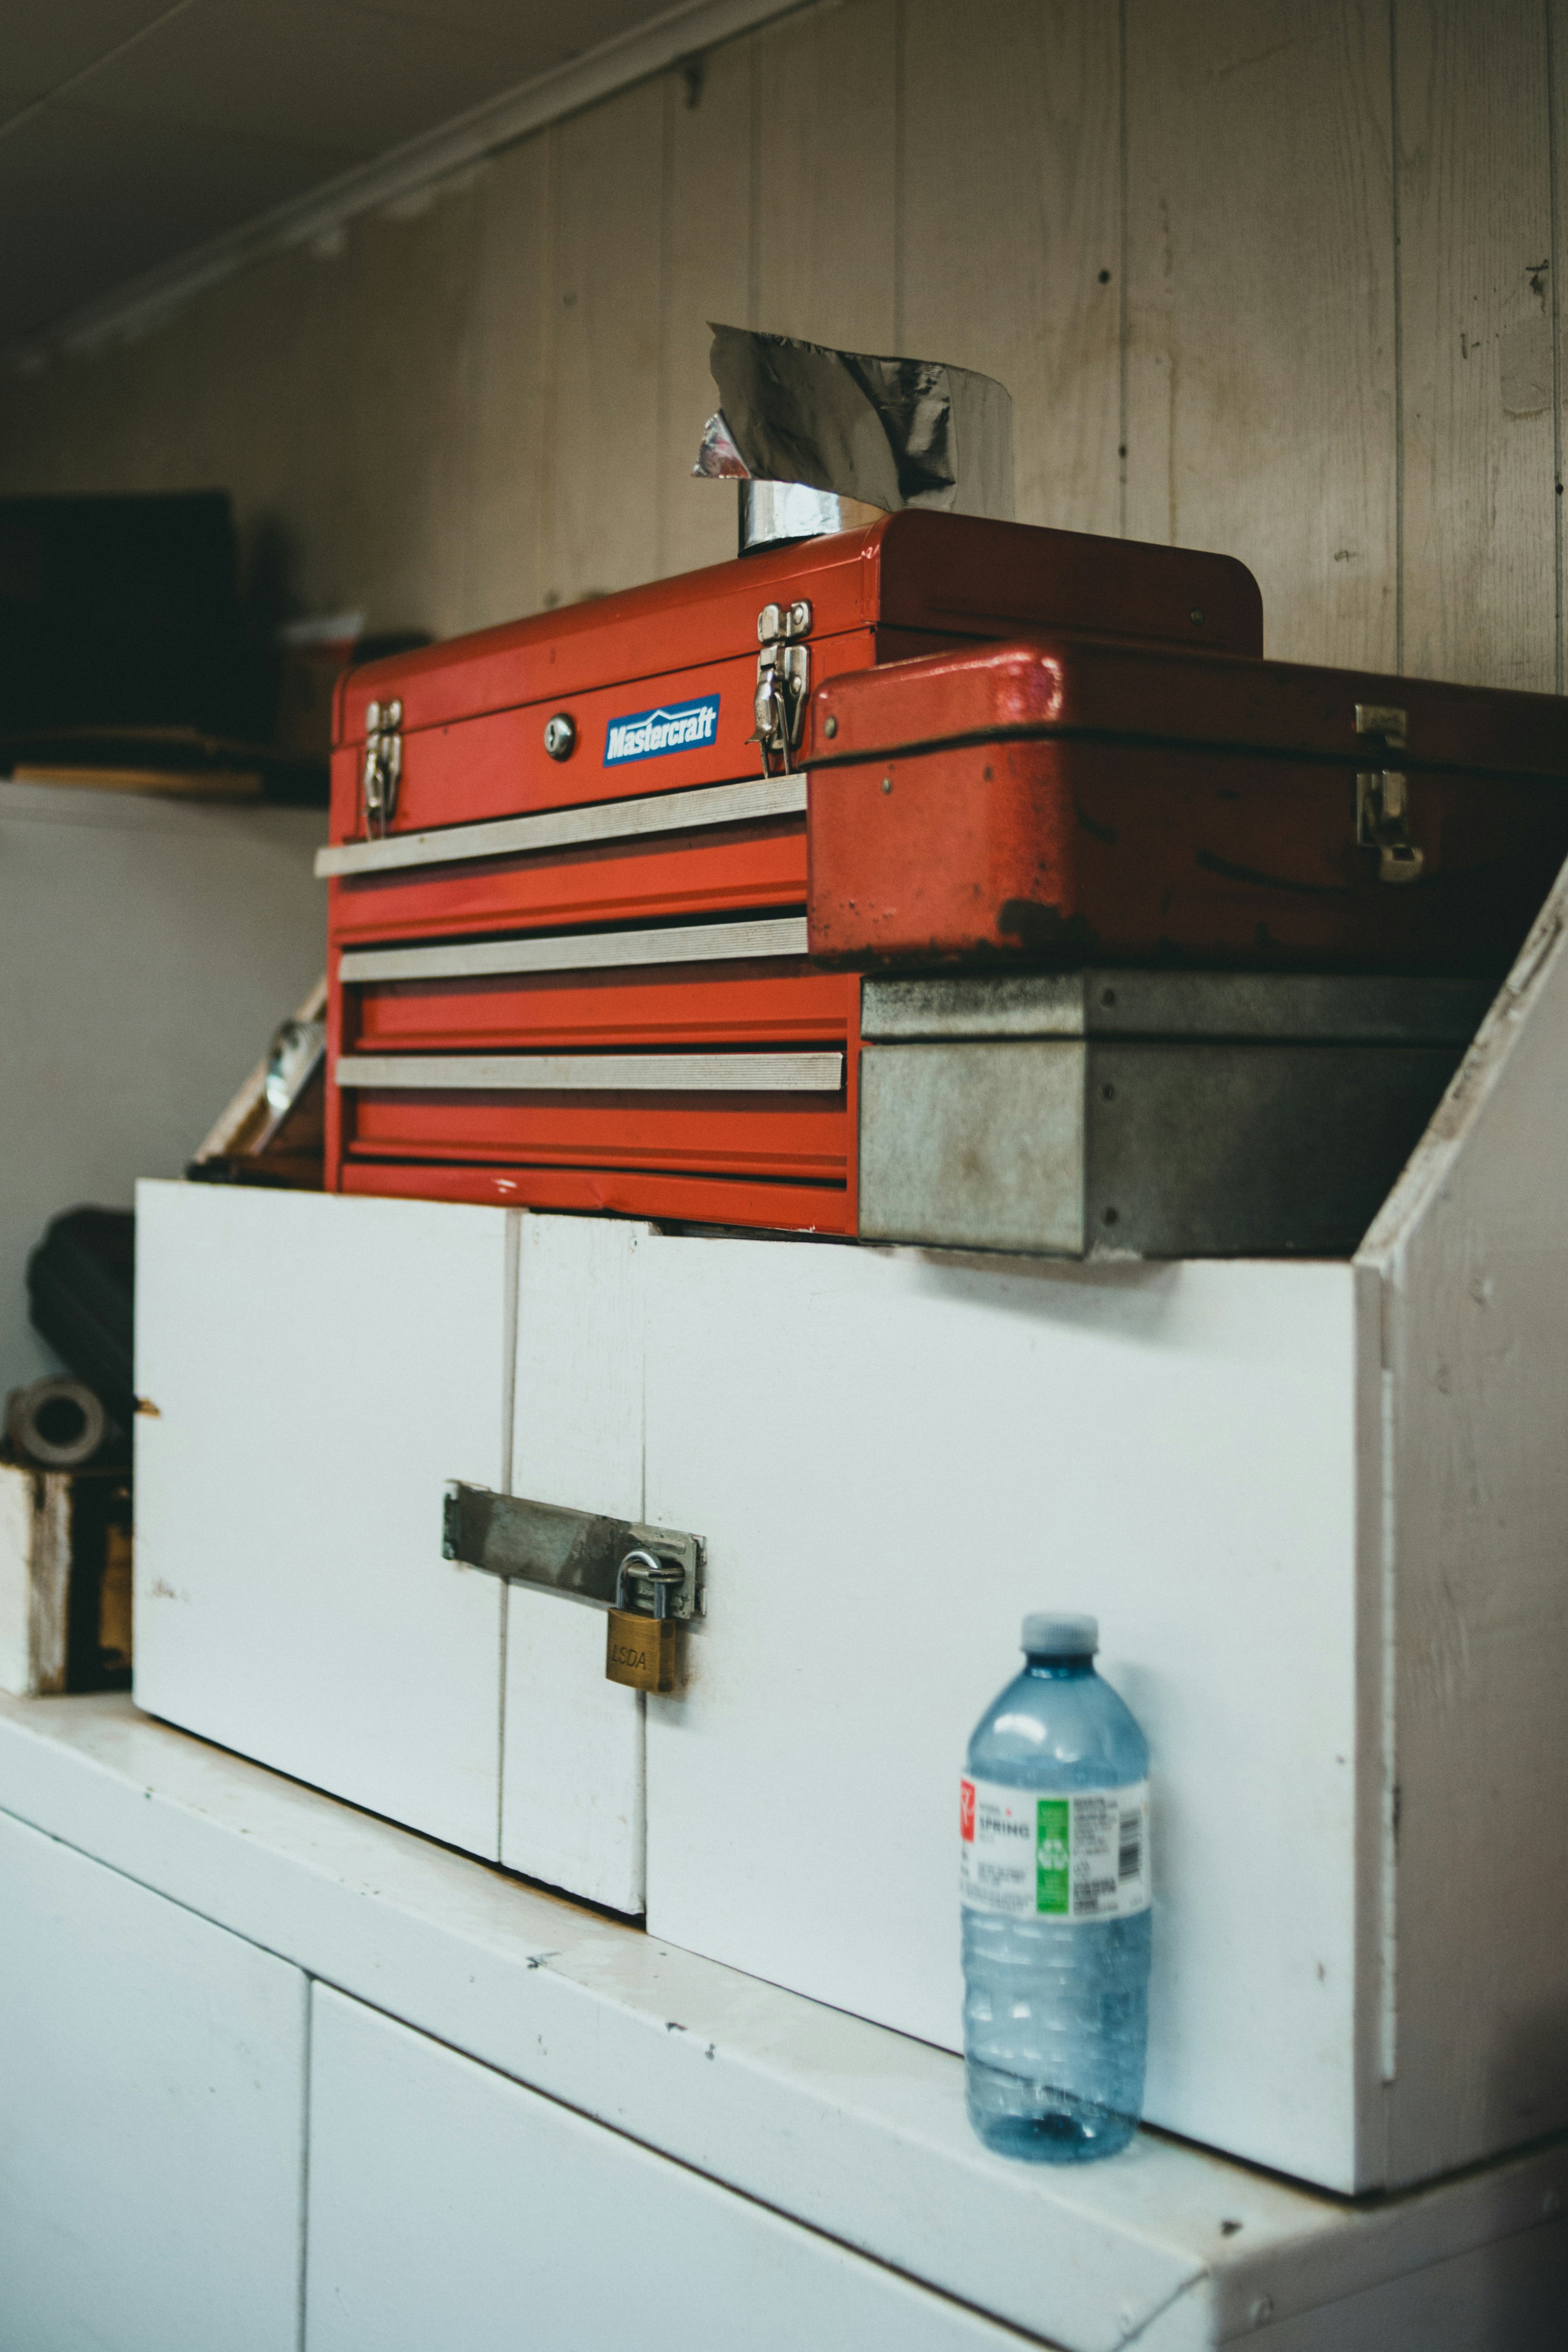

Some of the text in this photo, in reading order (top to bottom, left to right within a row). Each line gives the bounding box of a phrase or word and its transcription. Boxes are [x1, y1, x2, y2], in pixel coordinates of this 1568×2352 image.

[607, 706, 716, 760] Mastercraft
[612, 1644, 646, 1670] LSDA
[979, 1816, 1029, 1839] SPRING
